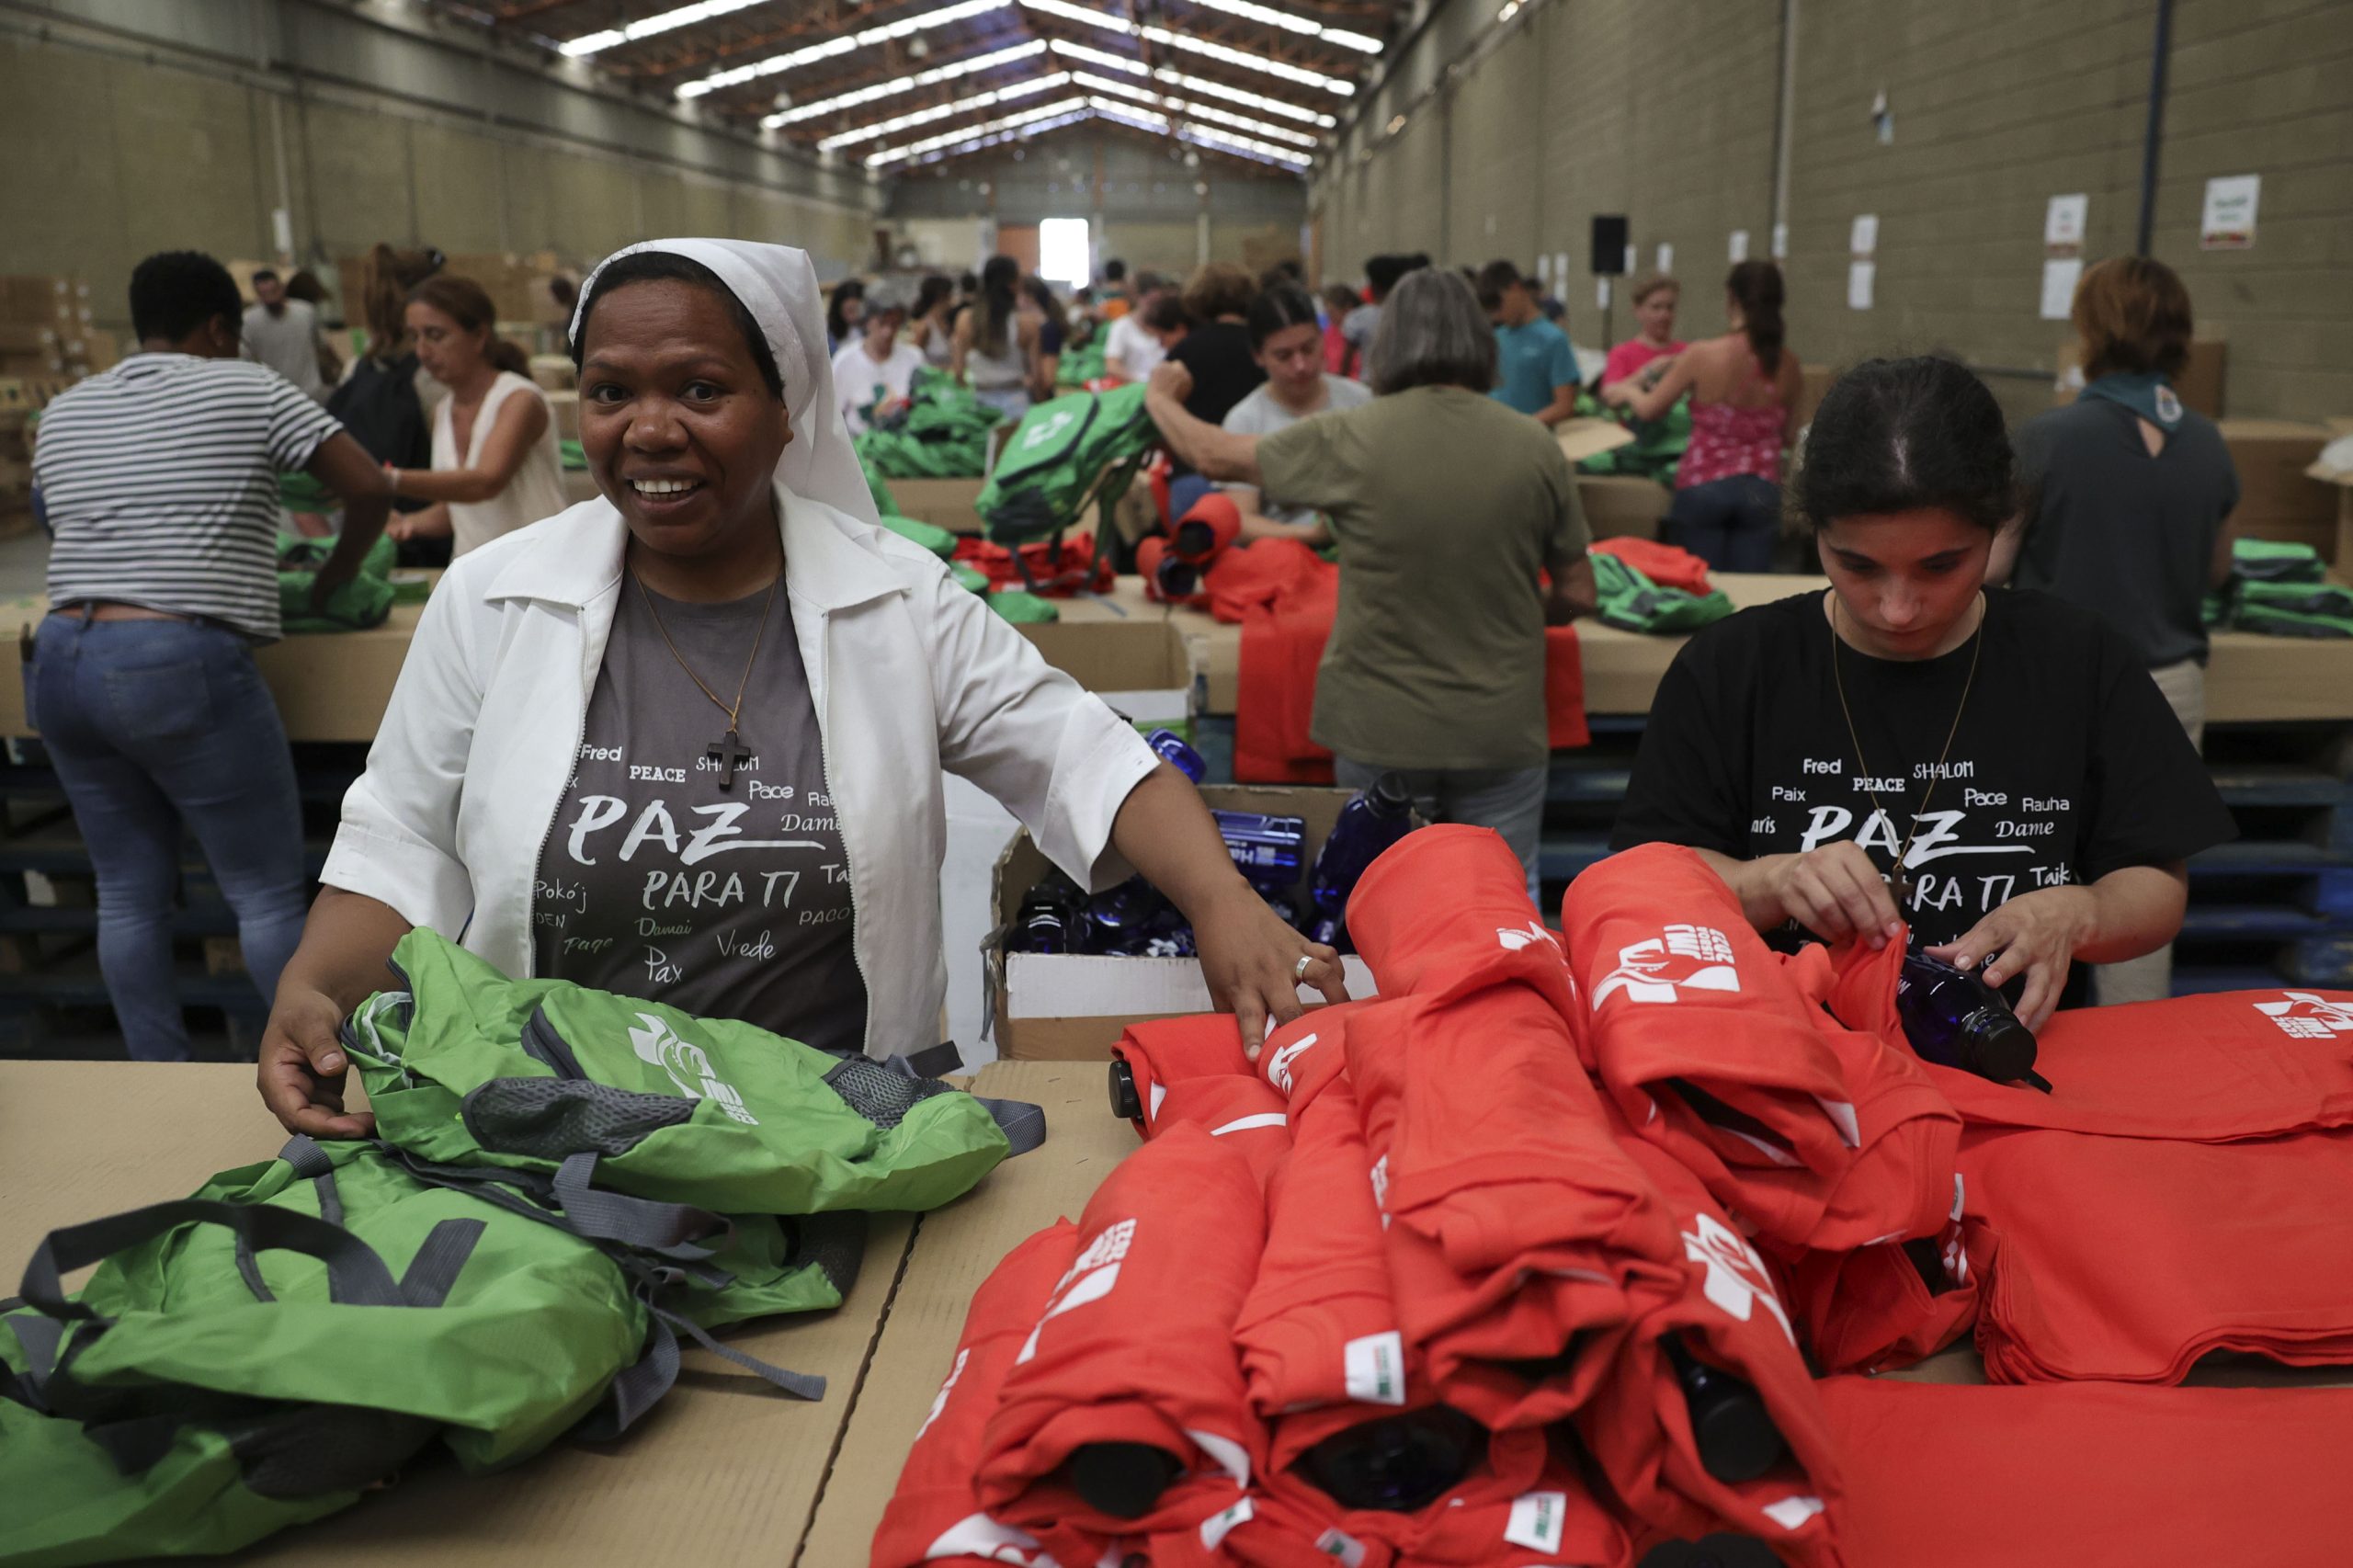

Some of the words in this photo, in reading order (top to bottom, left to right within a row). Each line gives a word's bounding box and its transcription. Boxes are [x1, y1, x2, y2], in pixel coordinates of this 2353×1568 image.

[580, 744, 622, 762] Fred
[629, 765, 686, 782] PEACE
[696, 756, 760, 772] SHOM
[1803, 758, 1842, 774] Fred
[1913, 760, 1974, 780] SHALOM
[748, 780, 794, 801] Pace
[1771, 786, 1807, 801] Paix
[1853, 777, 1905, 791] PEACE
[1964, 788, 2008, 808] Pace
[2022, 796, 2070, 812] Rauha
[568, 795, 826, 867] PAZ
[1801, 805, 2036, 869] PAZ
[1995, 820, 2055, 837] Dame
[642, 870, 745, 910] PARA
[760, 870, 801, 908] TI
[1976, 875, 2016, 912] TI
[717, 929, 777, 961] Vrede
[643, 944, 682, 984] Pax
